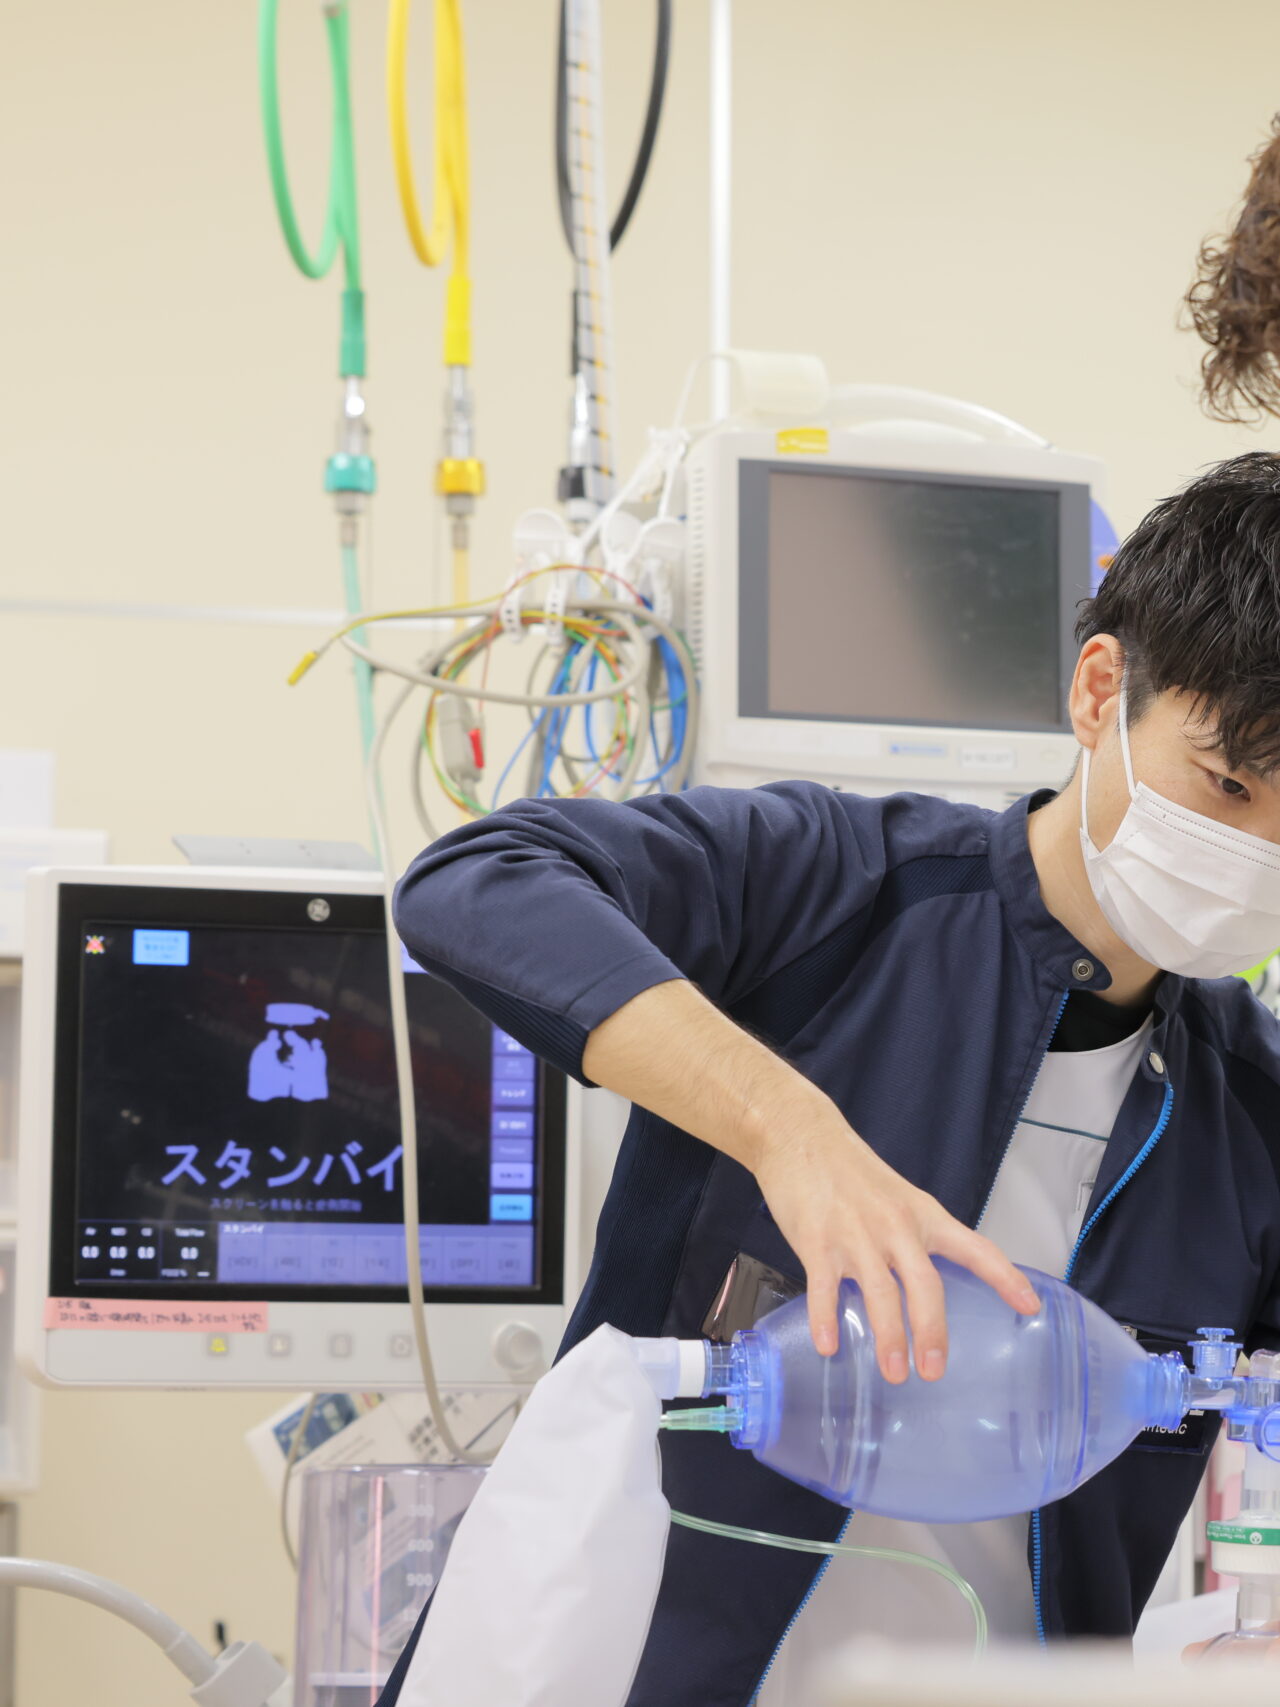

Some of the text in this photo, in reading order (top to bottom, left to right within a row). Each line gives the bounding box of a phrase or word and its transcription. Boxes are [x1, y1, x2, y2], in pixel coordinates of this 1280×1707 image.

[162, 1140, 404, 1192] スタンバイ
[223, 1224, 264, 1234] スタンバイ
[406, 1573, 432, 1586] 900
